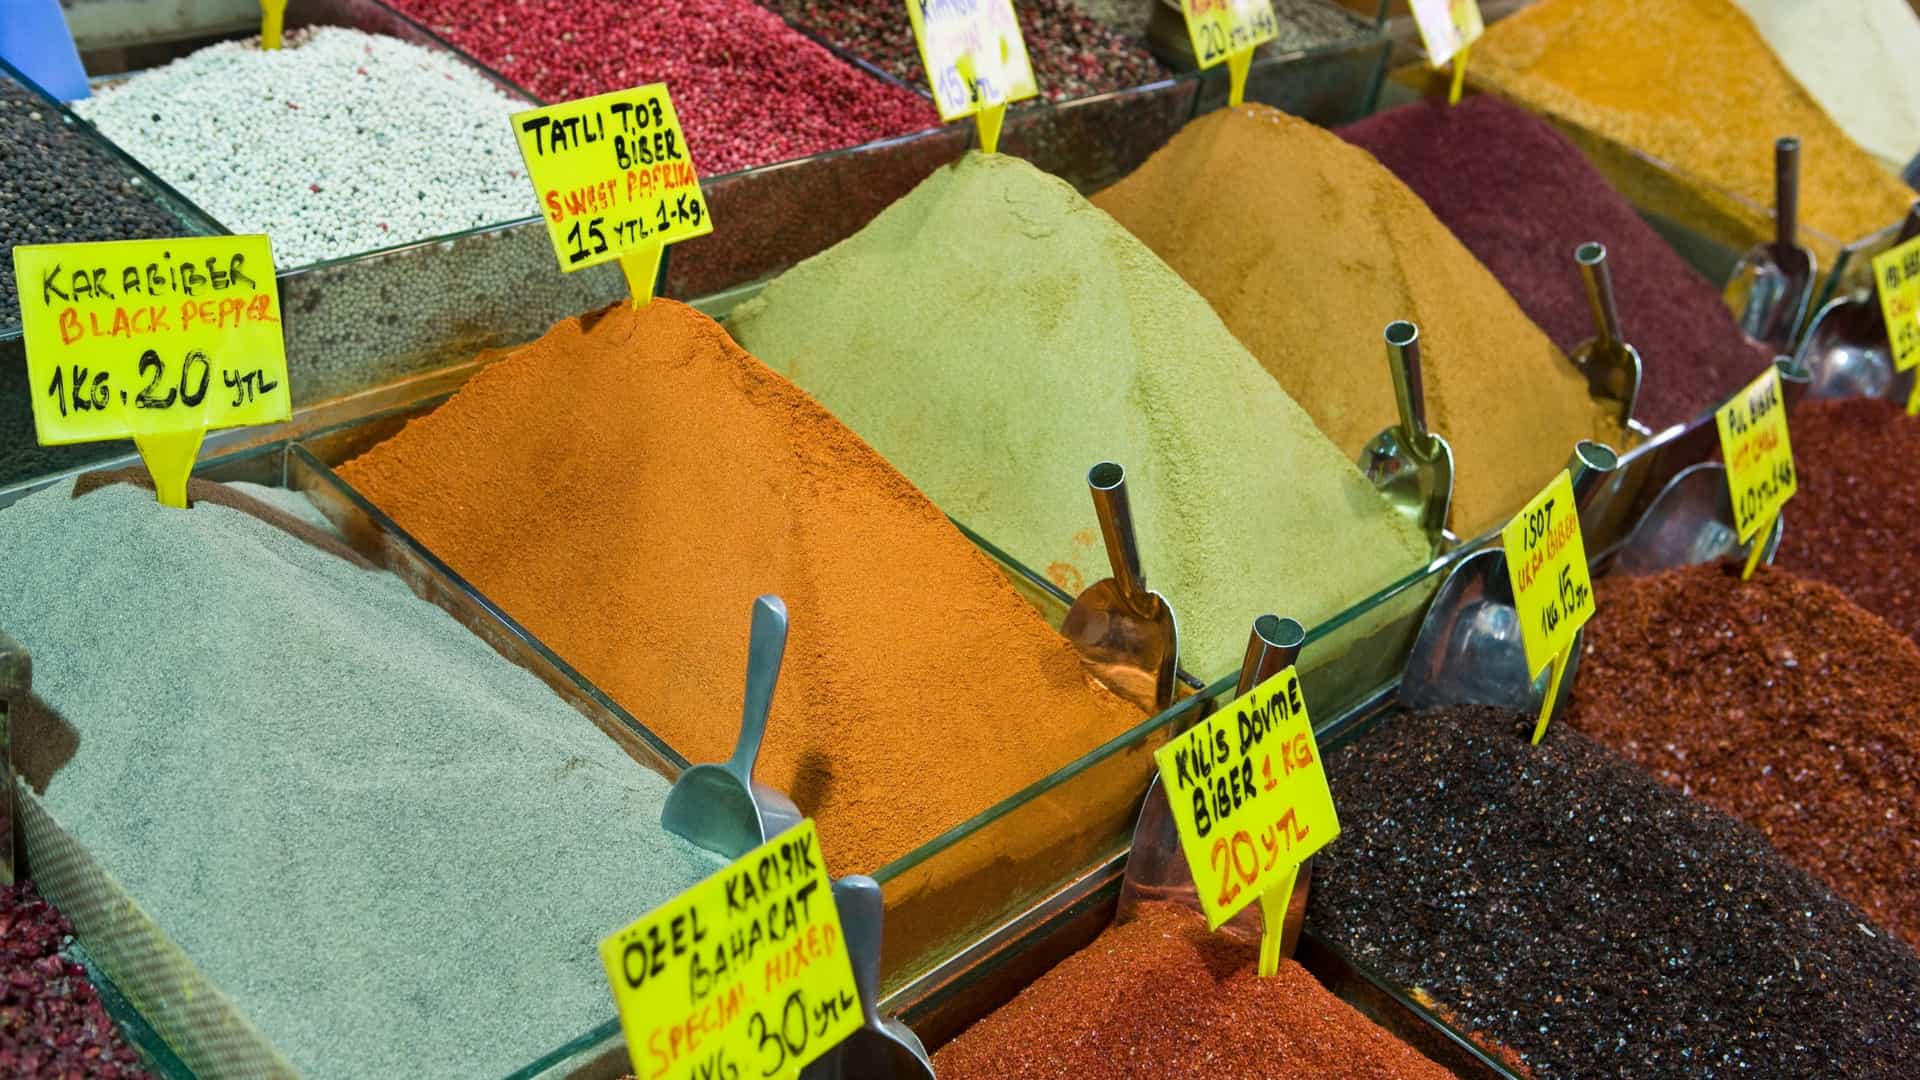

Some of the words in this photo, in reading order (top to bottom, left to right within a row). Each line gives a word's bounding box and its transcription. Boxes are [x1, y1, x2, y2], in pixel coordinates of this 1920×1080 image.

[1200, 21, 1226, 60] 20
[939, 65, 965, 107] 15
[522, 111, 605, 156] TATLI
[610, 97, 663, 132] TOZ
[566, 216, 609, 264] 15
[59, 306, 172, 345] BLACK
[180, 293, 280, 331] PEPPER
[134, 349, 211, 409] 20
[1740, 487, 1756, 529] 10
[1558, 563, 1576, 620] 15
[1237, 675, 1302, 757] DÖVME
[1260, 754, 1278, 792] 1
[1280, 732, 1314, 777] KG
[1211, 829, 1260, 908] 20
[748, 989, 808, 1079] 30
